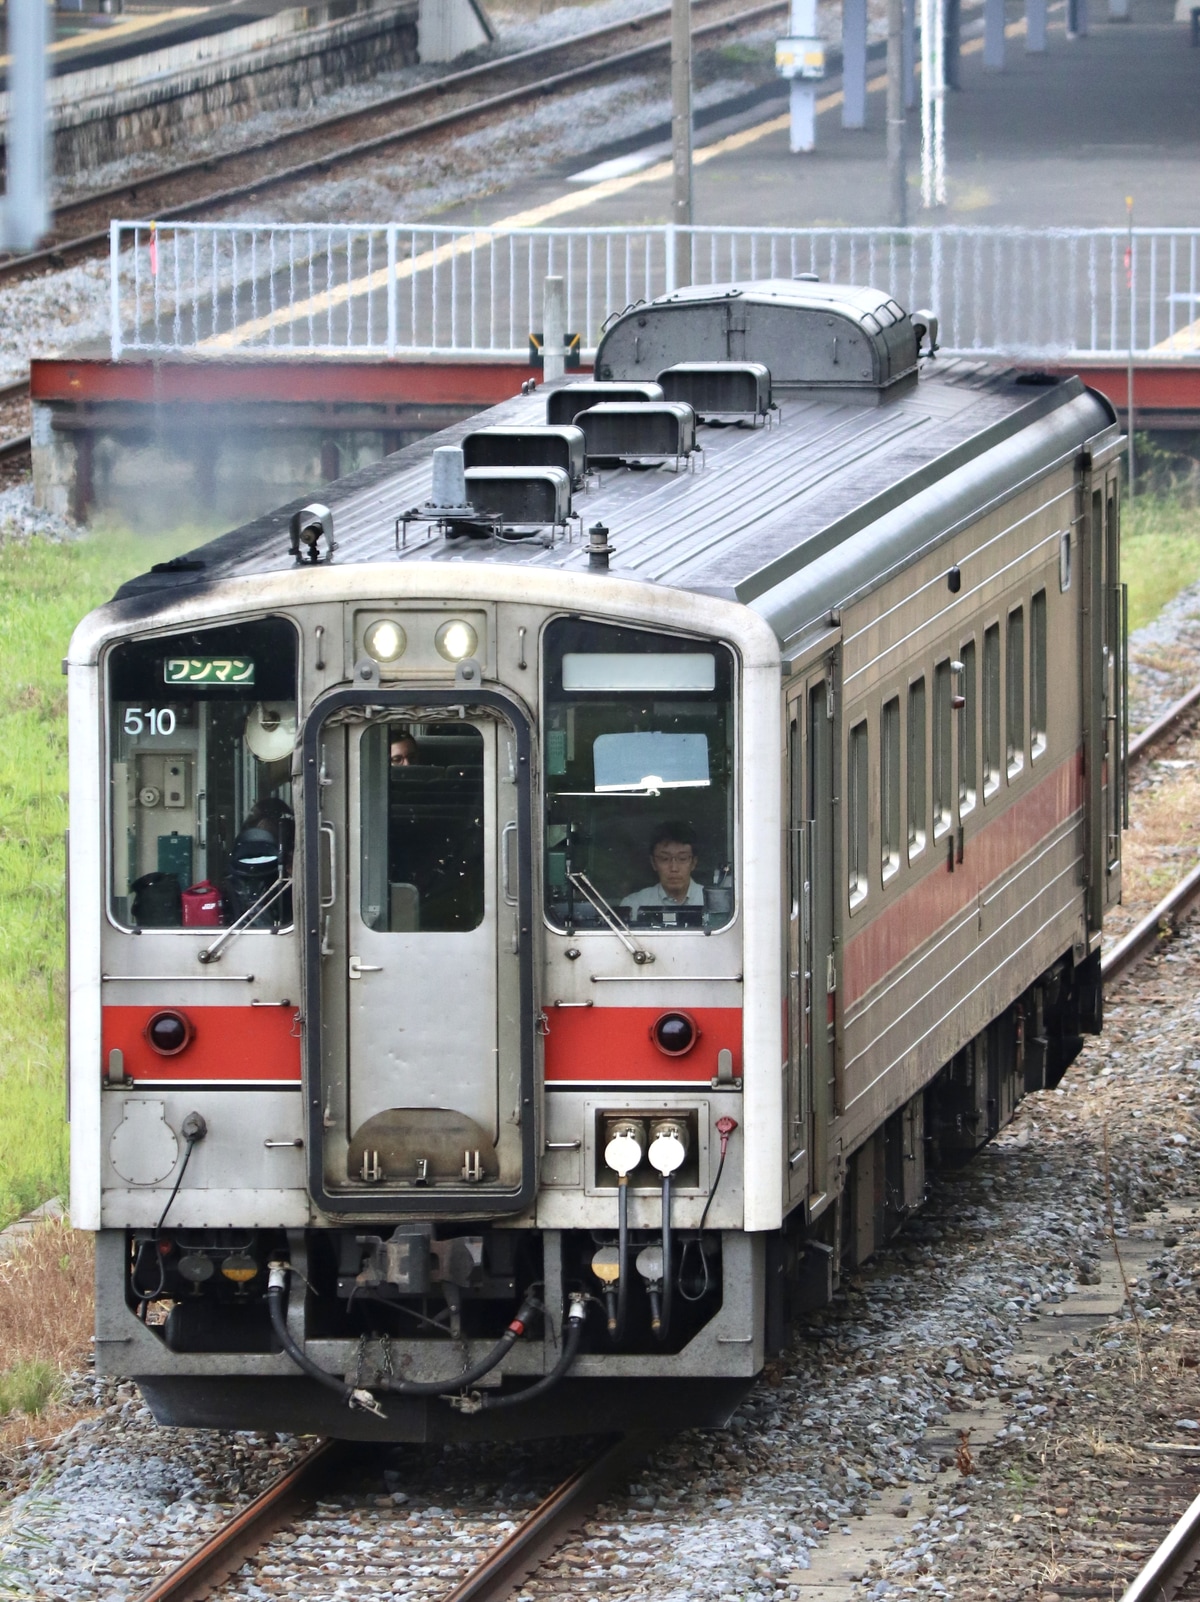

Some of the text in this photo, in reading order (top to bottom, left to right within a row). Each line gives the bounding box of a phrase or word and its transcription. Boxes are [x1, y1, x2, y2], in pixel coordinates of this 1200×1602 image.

[168, 660, 255, 681] ワンマン
[123, 708, 176, 735] 510
